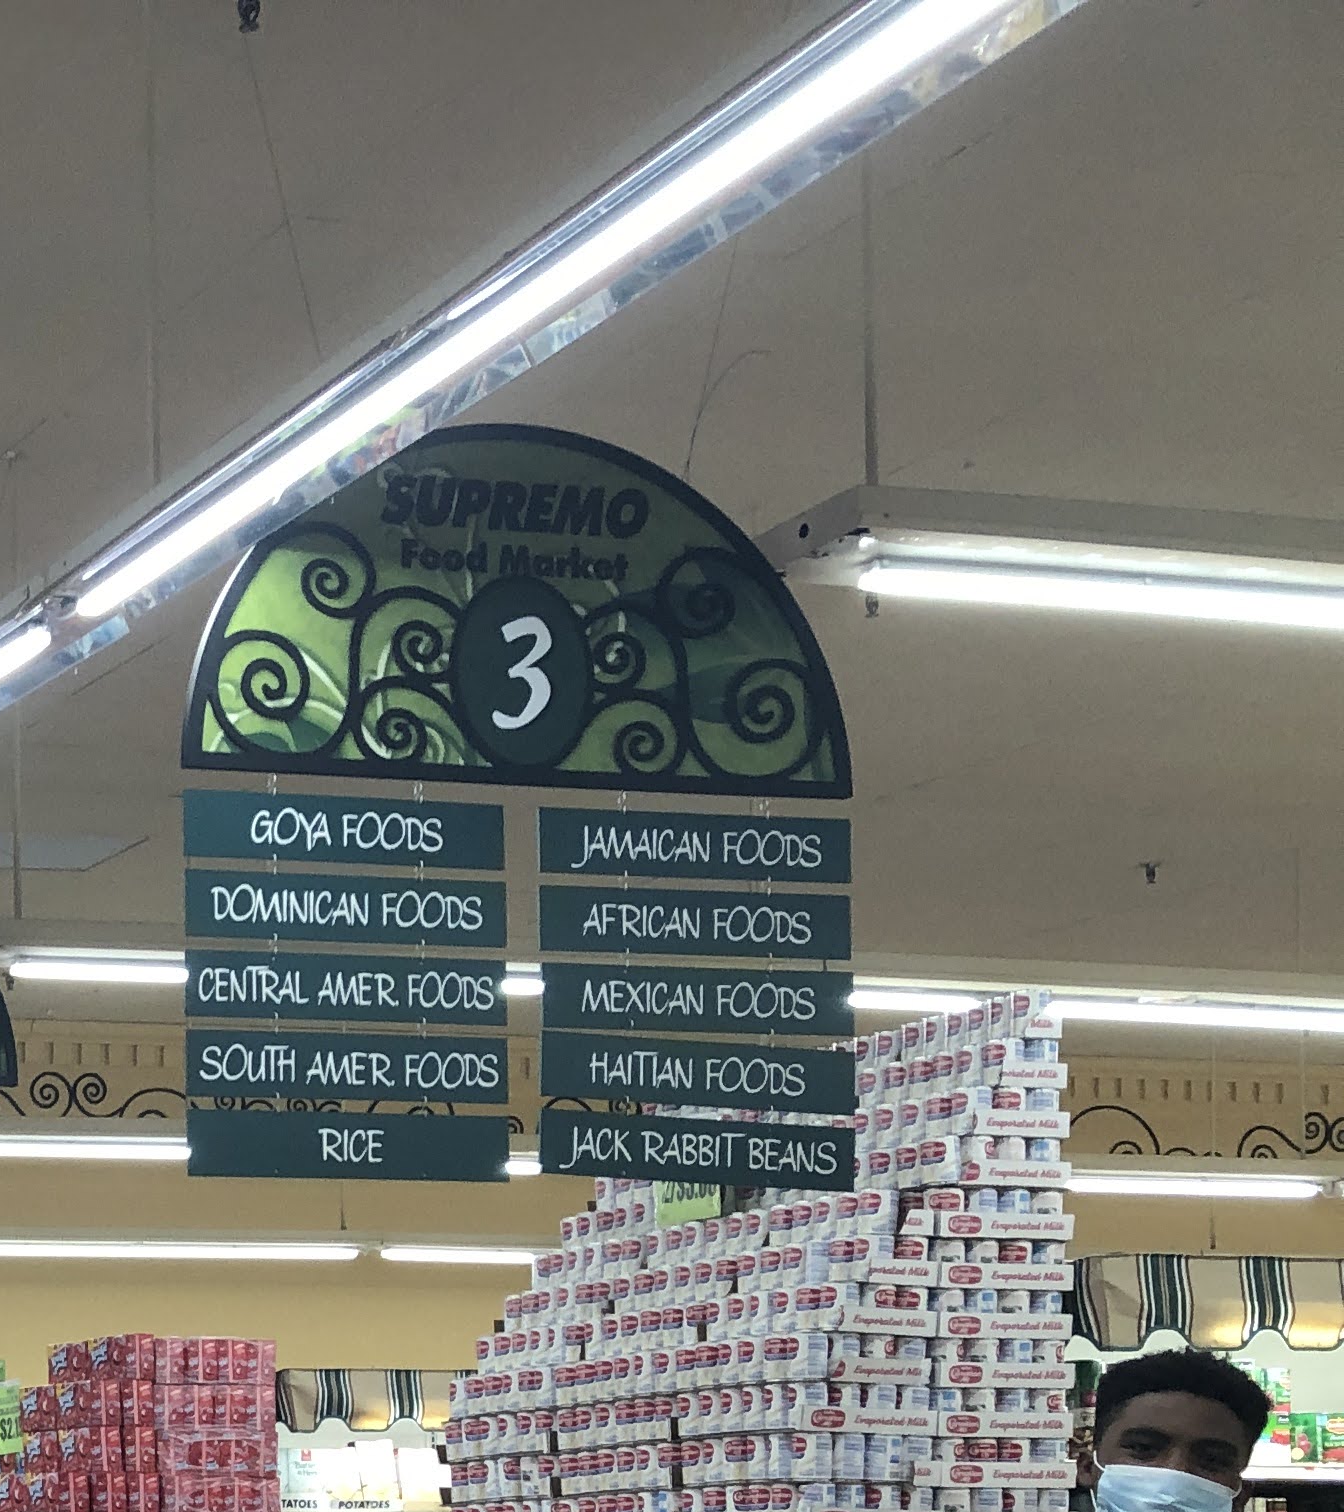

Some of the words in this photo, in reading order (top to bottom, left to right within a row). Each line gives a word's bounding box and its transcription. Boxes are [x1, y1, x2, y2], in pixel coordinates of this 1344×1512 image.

[381, 475, 648, 539] SUPREMO
[401, 538, 488, 574] Food
[500, 544, 630, 582] Market
[492, 616, 553, 729] 3
[251, 808, 331, 850] GOYA
[342, 811, 443, 852] FOODS
[572, 825, 711, 869] JAMAICAN
[723, 830, 822, 869] FOODS
[212, 885, 370, 925] DOMINICAN
[382, 889, 483, 931] FOODS
[583, 904, 701, 940] AFRICAN
[713, 908, 811, 944] FOODS
[198, 965, 310, 1005] CENTRAL
[407, 971, 494, 1011] FOODS
[581, 980, 703, 1016] MEXICAN
[716, 982, 816, 1021] FOODS
[200, 1044, 296, 1082] SOUTH
[404, 1051, 498, 1091] FOODS
[591, 1051, 694, 1090] HAITIAN
[704, 1057, 806, 1096] FOODS
[318, 1128, 383, 1163] RICE
[562, 1128, 630, 1169] JACK
[642, 1132, 741, 1169] RABBIT
[750, 1138, 837, 1175] BEANS
[281, 1500, 317, 1509] TATOES
[338, 1500, 390, 1509] POTATOES
